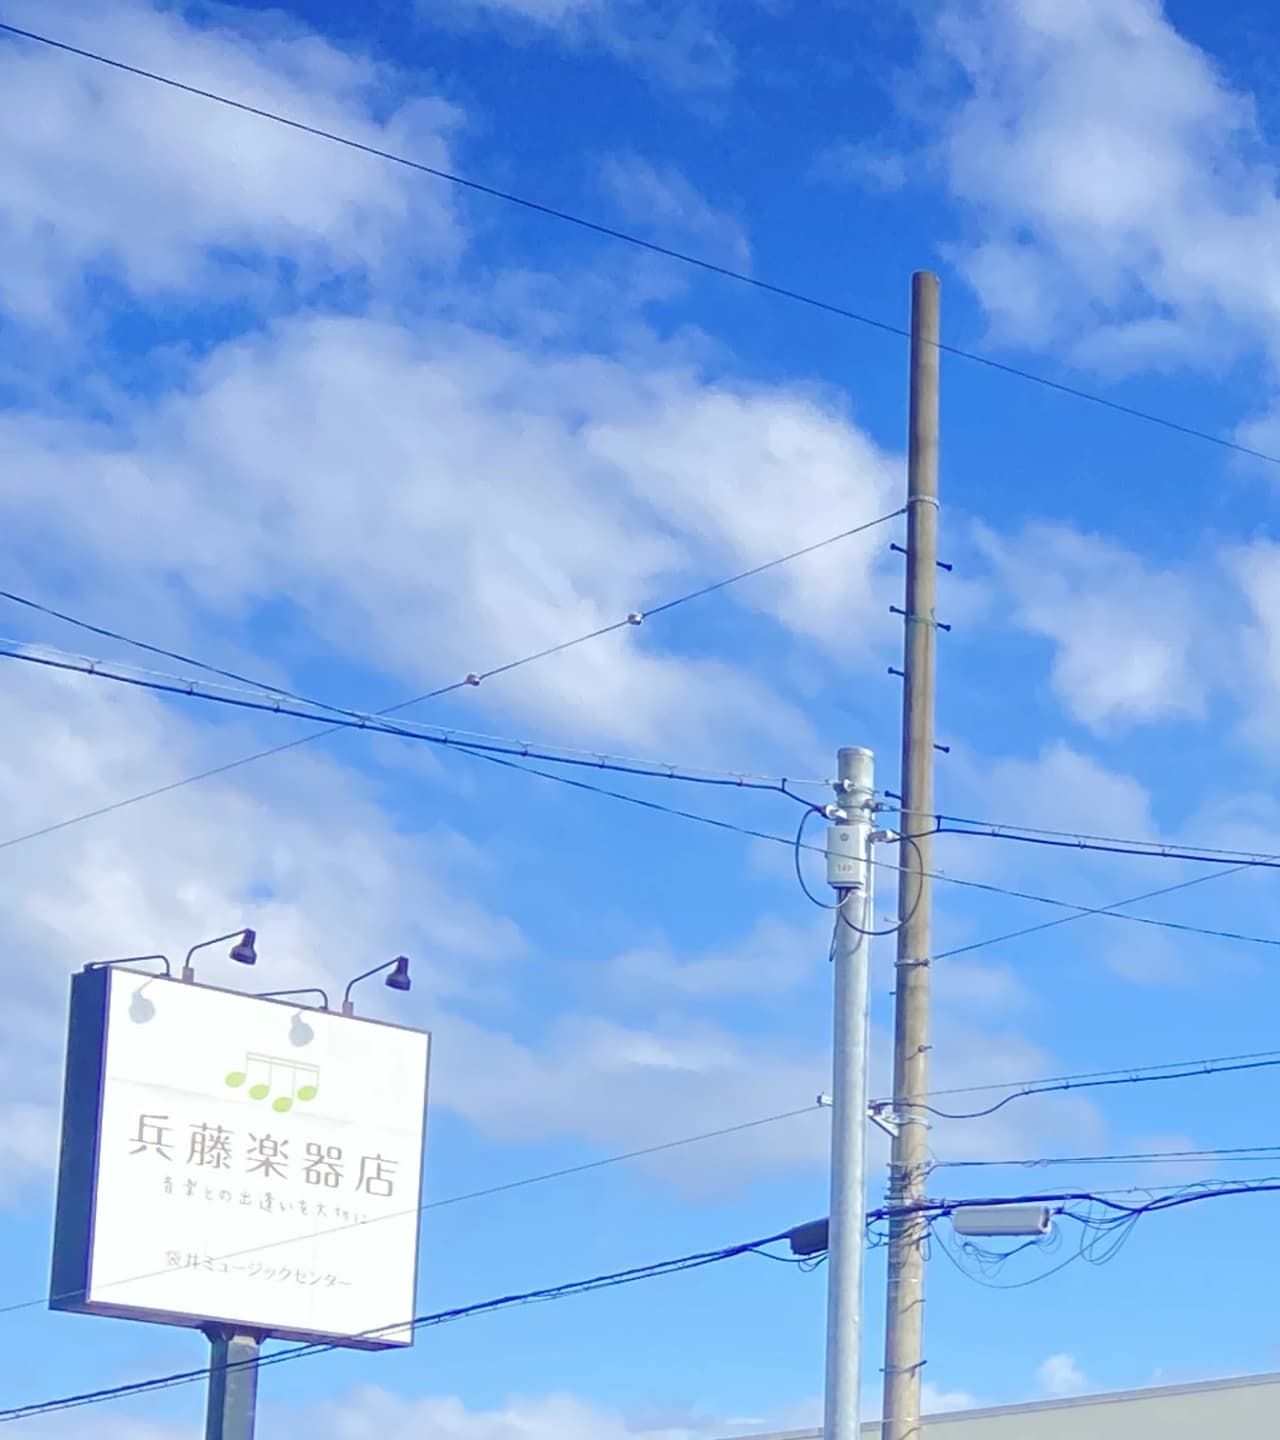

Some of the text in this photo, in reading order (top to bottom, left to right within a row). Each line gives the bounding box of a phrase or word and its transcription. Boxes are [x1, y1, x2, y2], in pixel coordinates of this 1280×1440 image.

[128, 1114, 399, 1198] 兵藤楽器店
